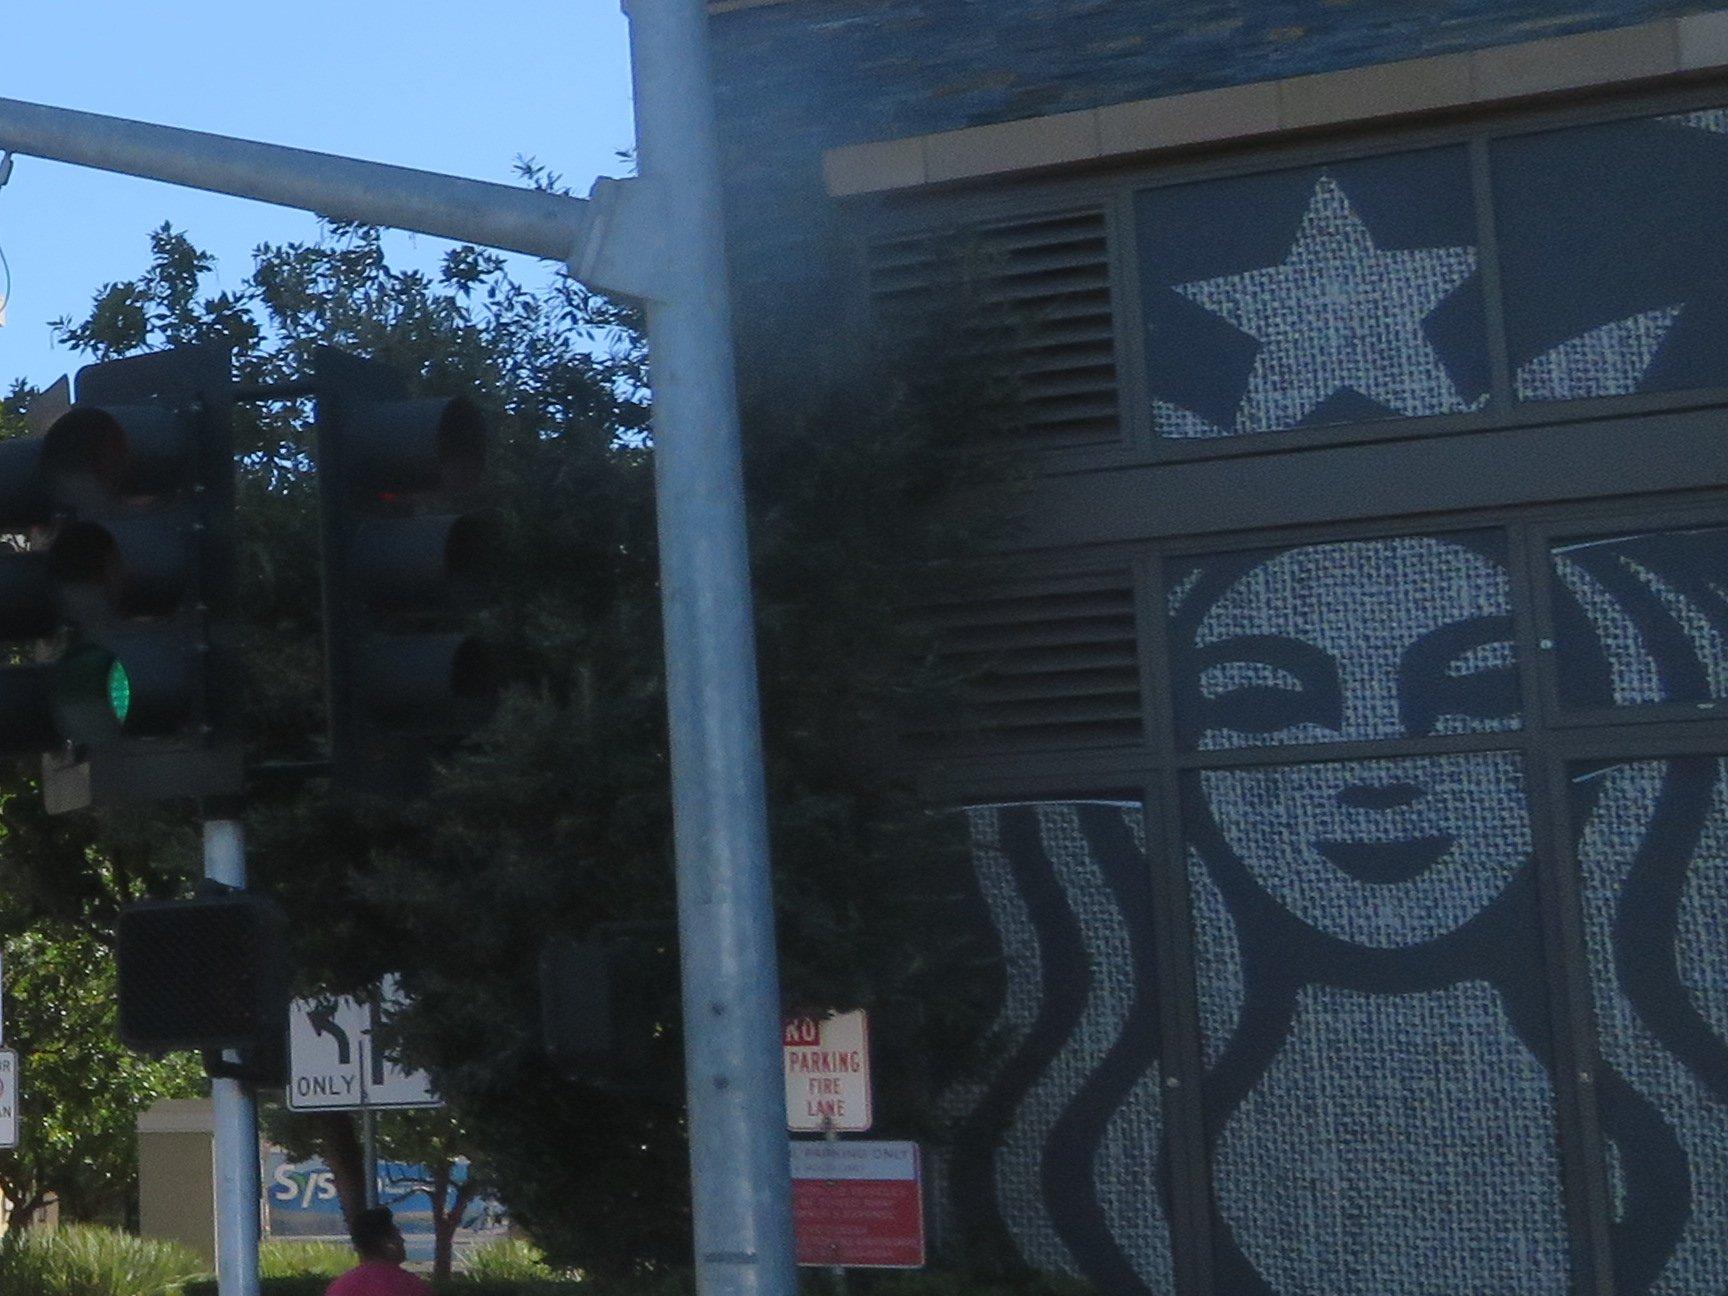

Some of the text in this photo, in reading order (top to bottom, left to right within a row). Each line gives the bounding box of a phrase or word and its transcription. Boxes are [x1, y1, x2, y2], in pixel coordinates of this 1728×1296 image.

[789, 1051, 861, 1073] PARKING
[297, 1075, 355, 1097] ONLY
[808, 1078, 841, 1095] FIRE
[808, 1100, 845, 1117] LANE
